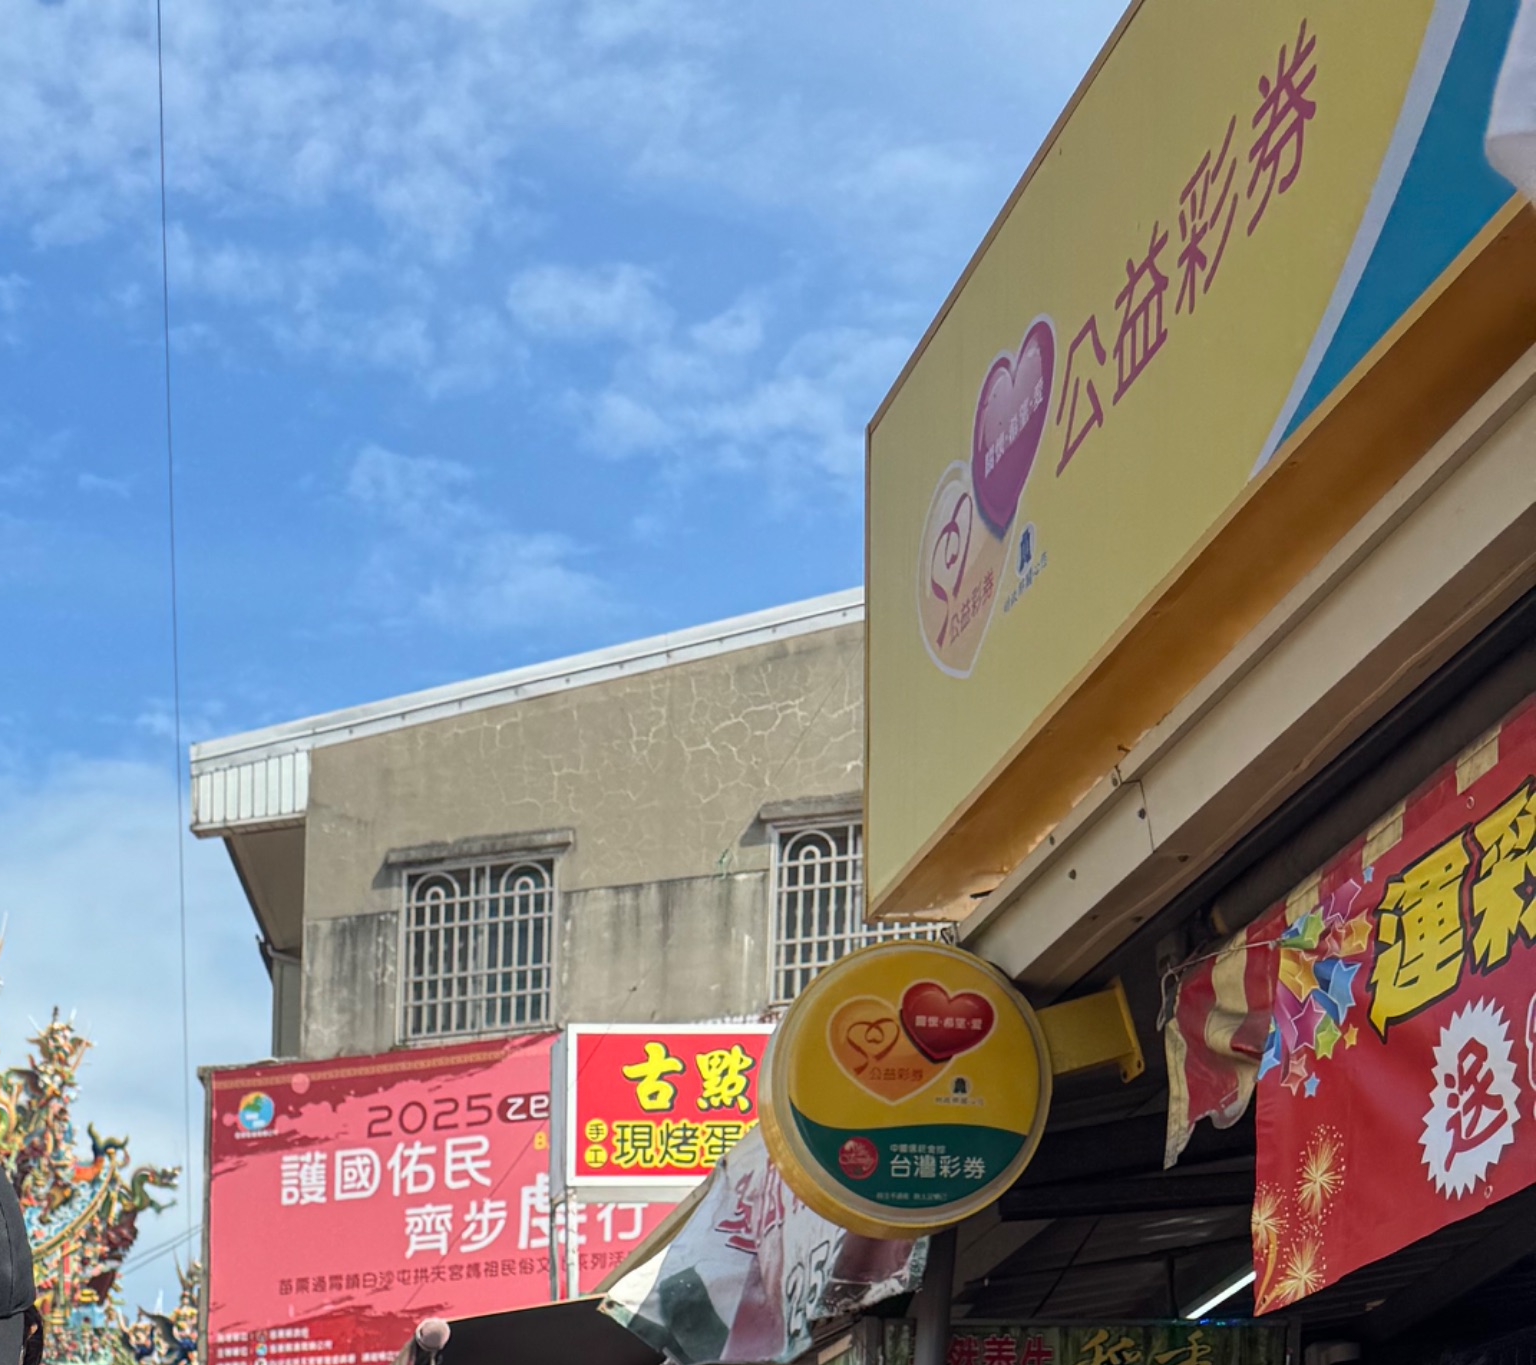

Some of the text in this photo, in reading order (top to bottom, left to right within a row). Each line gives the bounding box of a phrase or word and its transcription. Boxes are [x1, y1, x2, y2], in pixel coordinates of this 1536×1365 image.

[1056, 17, 1317, 478] 公益彩券
[949, 567, 995, 646] 公益彩券
[868, 1067, 924, 1082] 公益彩券
[366, 1093, 493, 1139] 2025
[586, 1120, 607, 1166] 手工
[614, 1120, 759, 1166] 現烤蛋
[280, 1135, 492, 1206] 護國佑民
[889, 1155, 986, 1180] 台灣彩券
